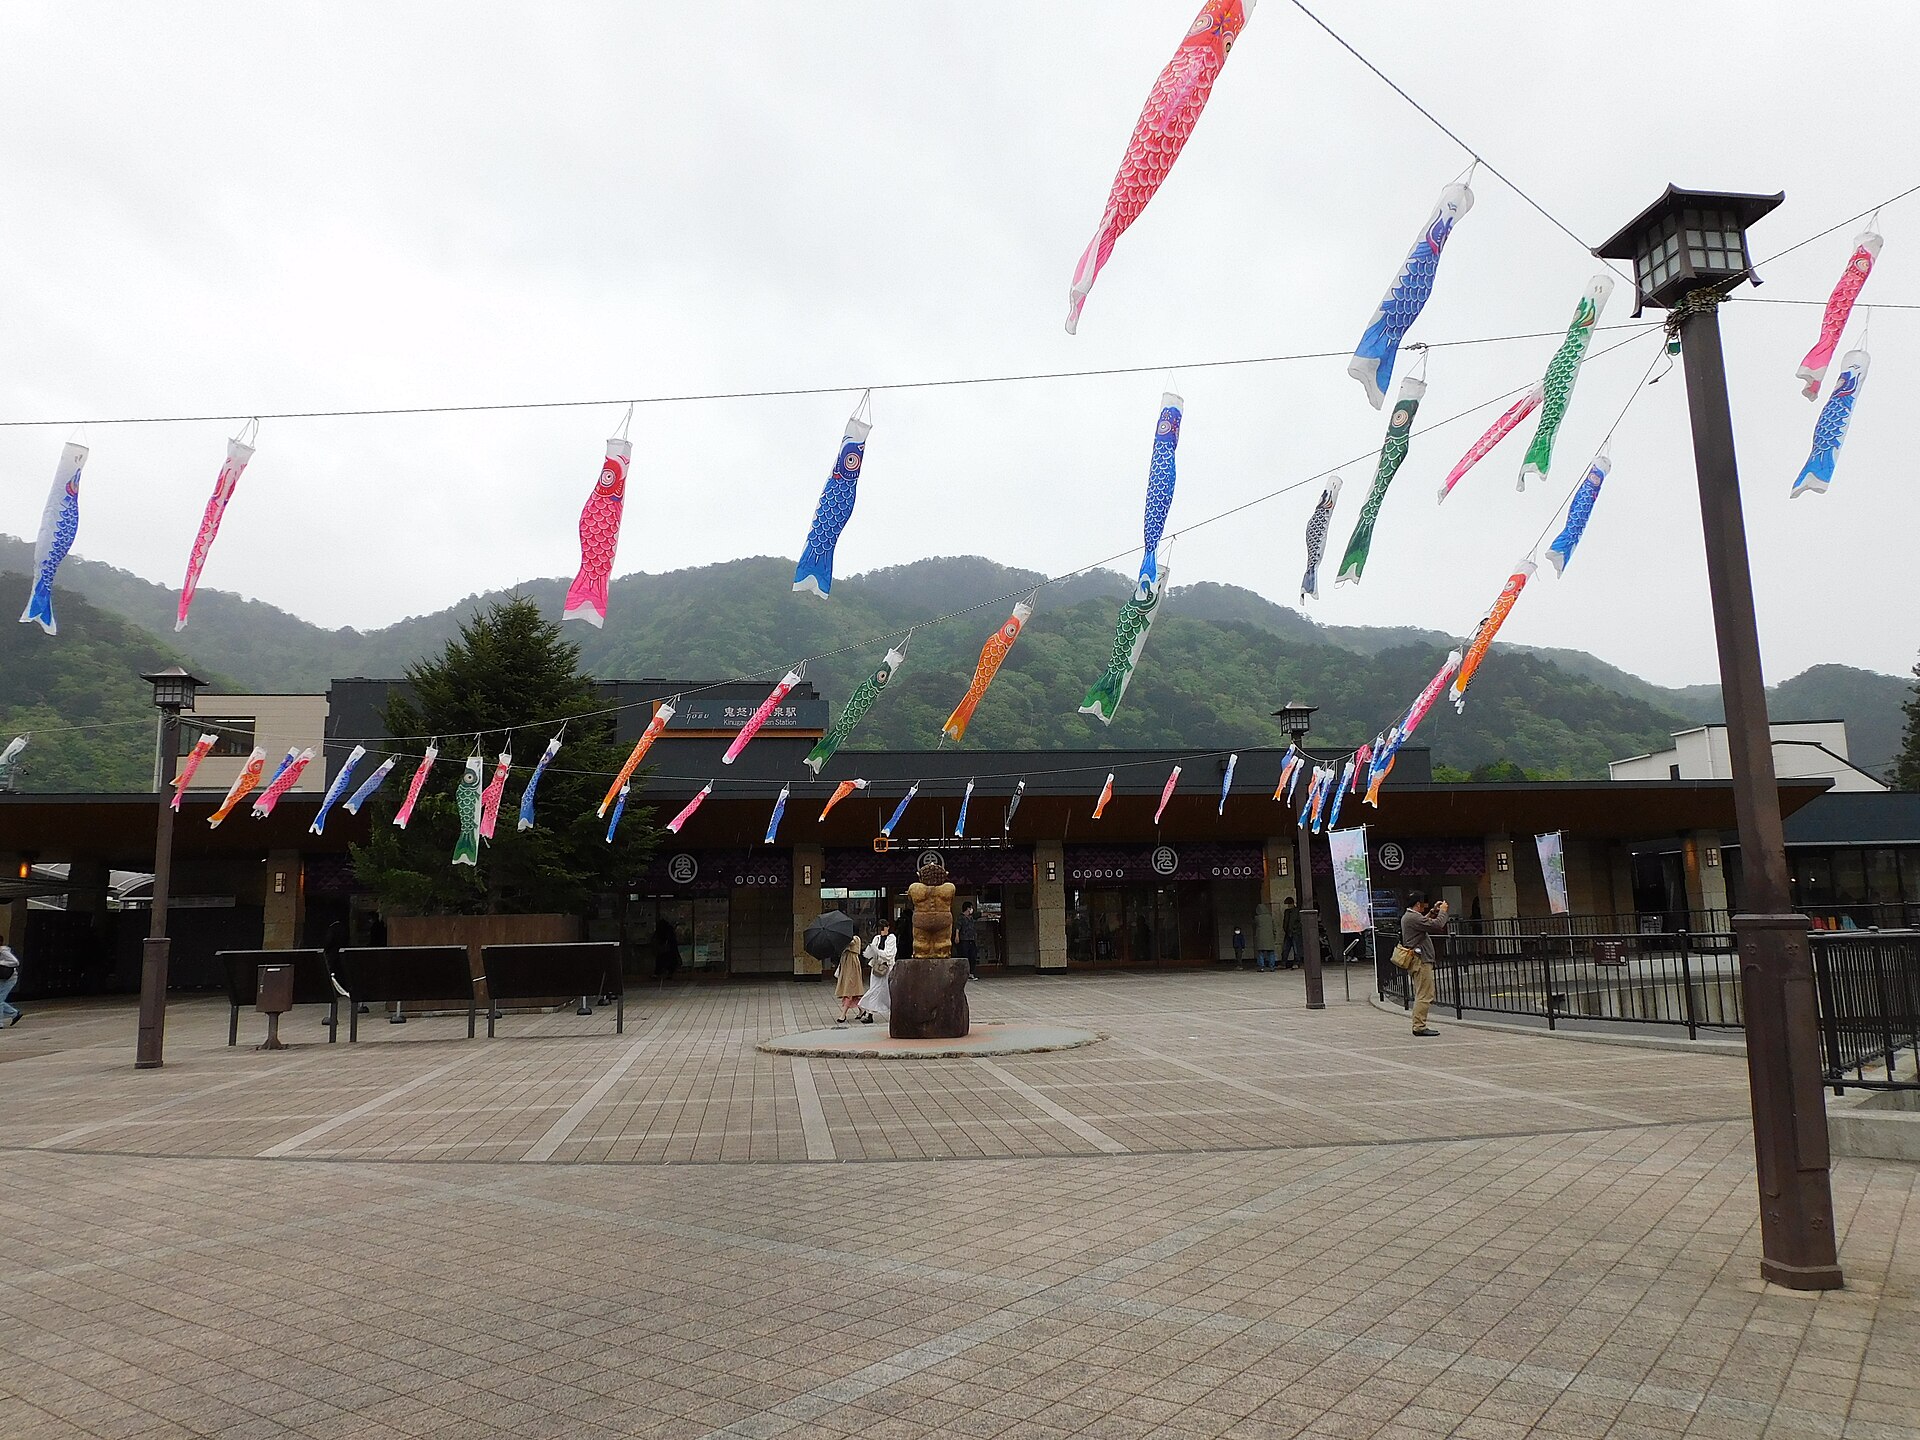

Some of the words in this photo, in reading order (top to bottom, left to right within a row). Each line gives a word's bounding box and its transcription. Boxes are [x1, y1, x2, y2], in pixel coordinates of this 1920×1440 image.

[723, 706, 797, 718] 鬼怒川泉駅
[775, 718, 797, 726] Station
